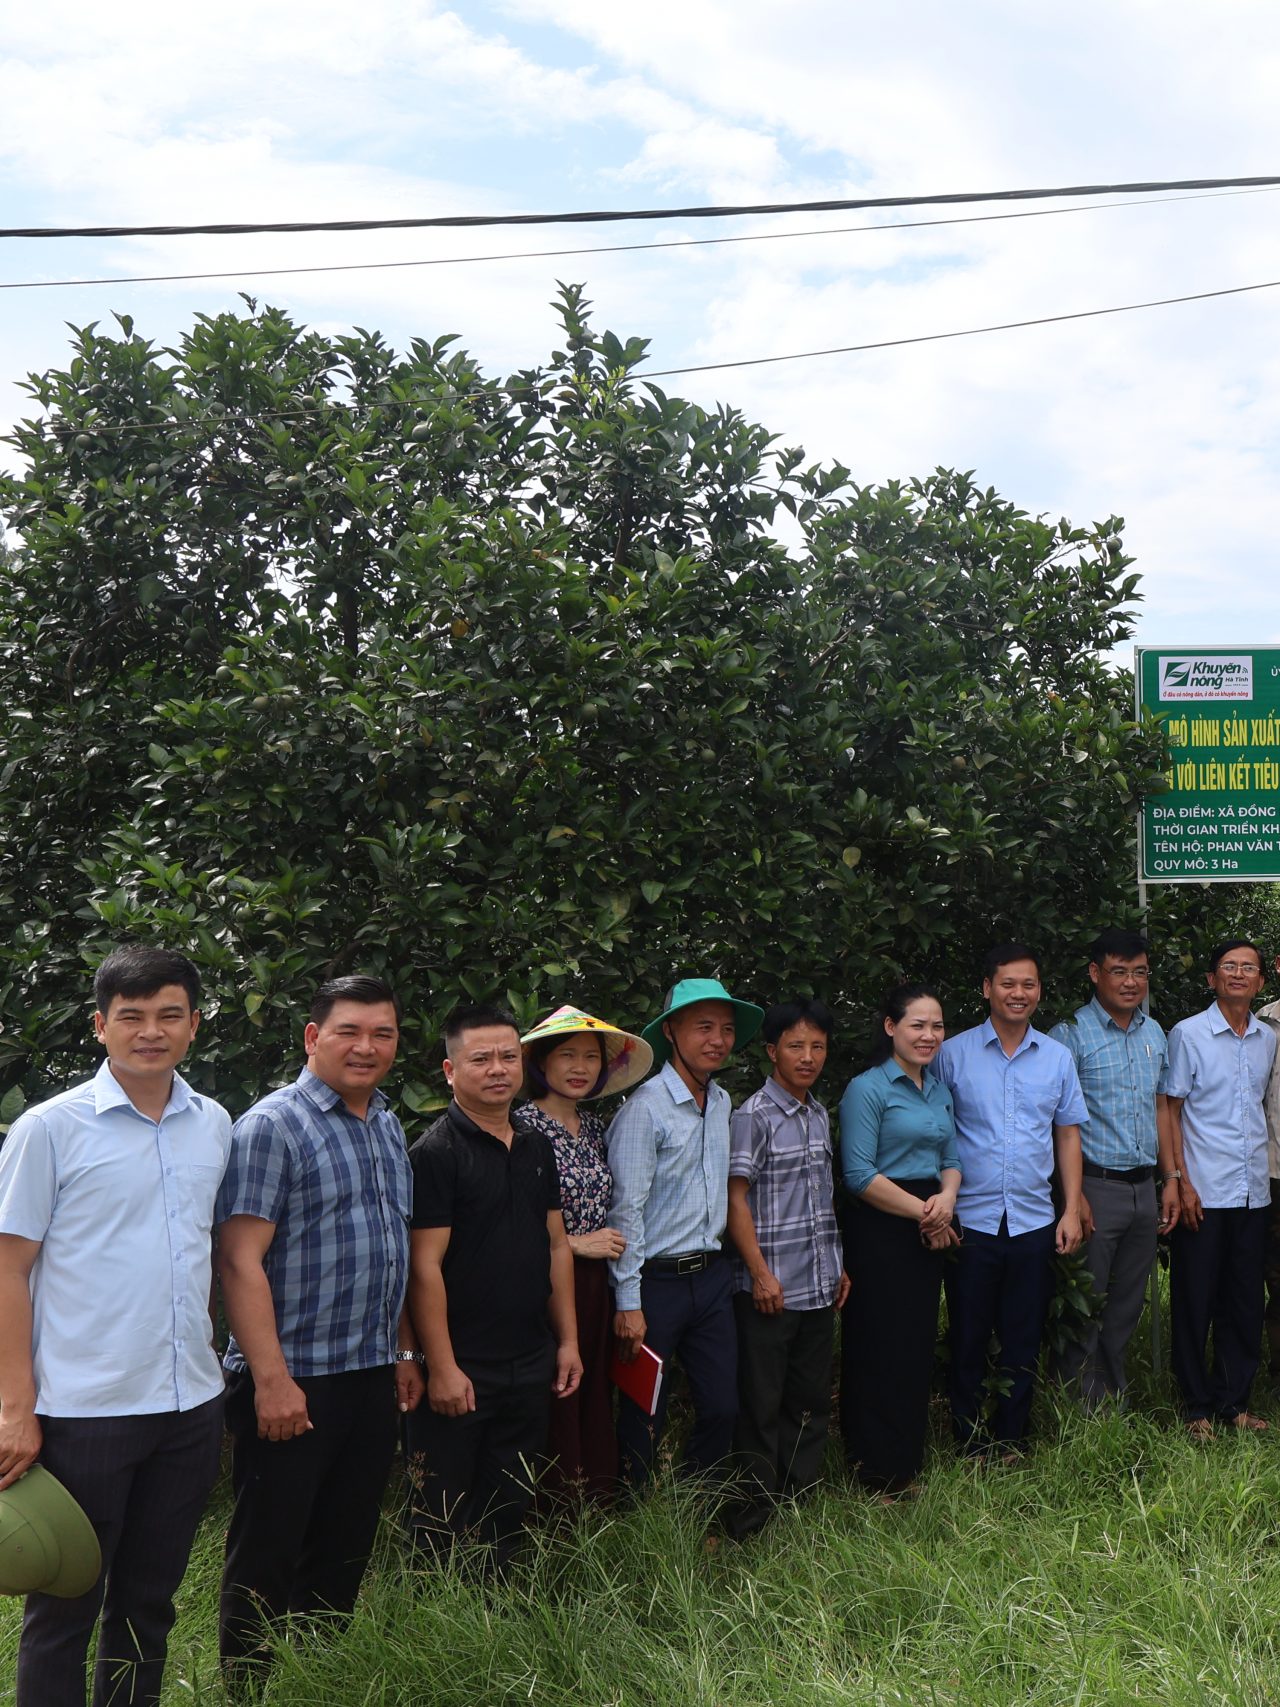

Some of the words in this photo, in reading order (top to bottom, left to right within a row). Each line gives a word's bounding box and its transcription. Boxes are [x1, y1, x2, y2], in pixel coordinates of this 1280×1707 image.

[1190, 675, 1224, 690] nông
[1191, 714, 1220, 747] HÌNH
[1223, 710, 1248, 747] SẢN
[1251, 709, 1280, 746] XUẤT
[1176, 757, 1196, 790] VỚI
[1199, 757, 1225, 790] LIÊN
[1229, 754, 1250, 790] KẾT
[1253, 756, 1279, 790] TIÊU
[1153, 808, 1176, 820] ĐỊA
[1179, 804, 1215, 818] ĐIỂM:
[1218, 805, 1235, 817] XÃ
[1238, 804, 1276, 817] ĐỒNG
[1153, 823, 1184, 835] THỜI
[1187, 825, 1218, 835] GIAN
[1221, 821, 1258, 835] TRIỂN
[1153, 840, 1178, 852] TÊN
[1181, 840, 1204, 854] HỘ:
[1207, 842, 1243, 852] PHAN
[1246, 839, 1273, 851] VĂN
[1154, 860, 1181, 871] QUY
[1184, 857, 1208, 869] MÔ:
[1211, 859, 1219, 869] 3
[1222, 859, 1239, 869] Ha
